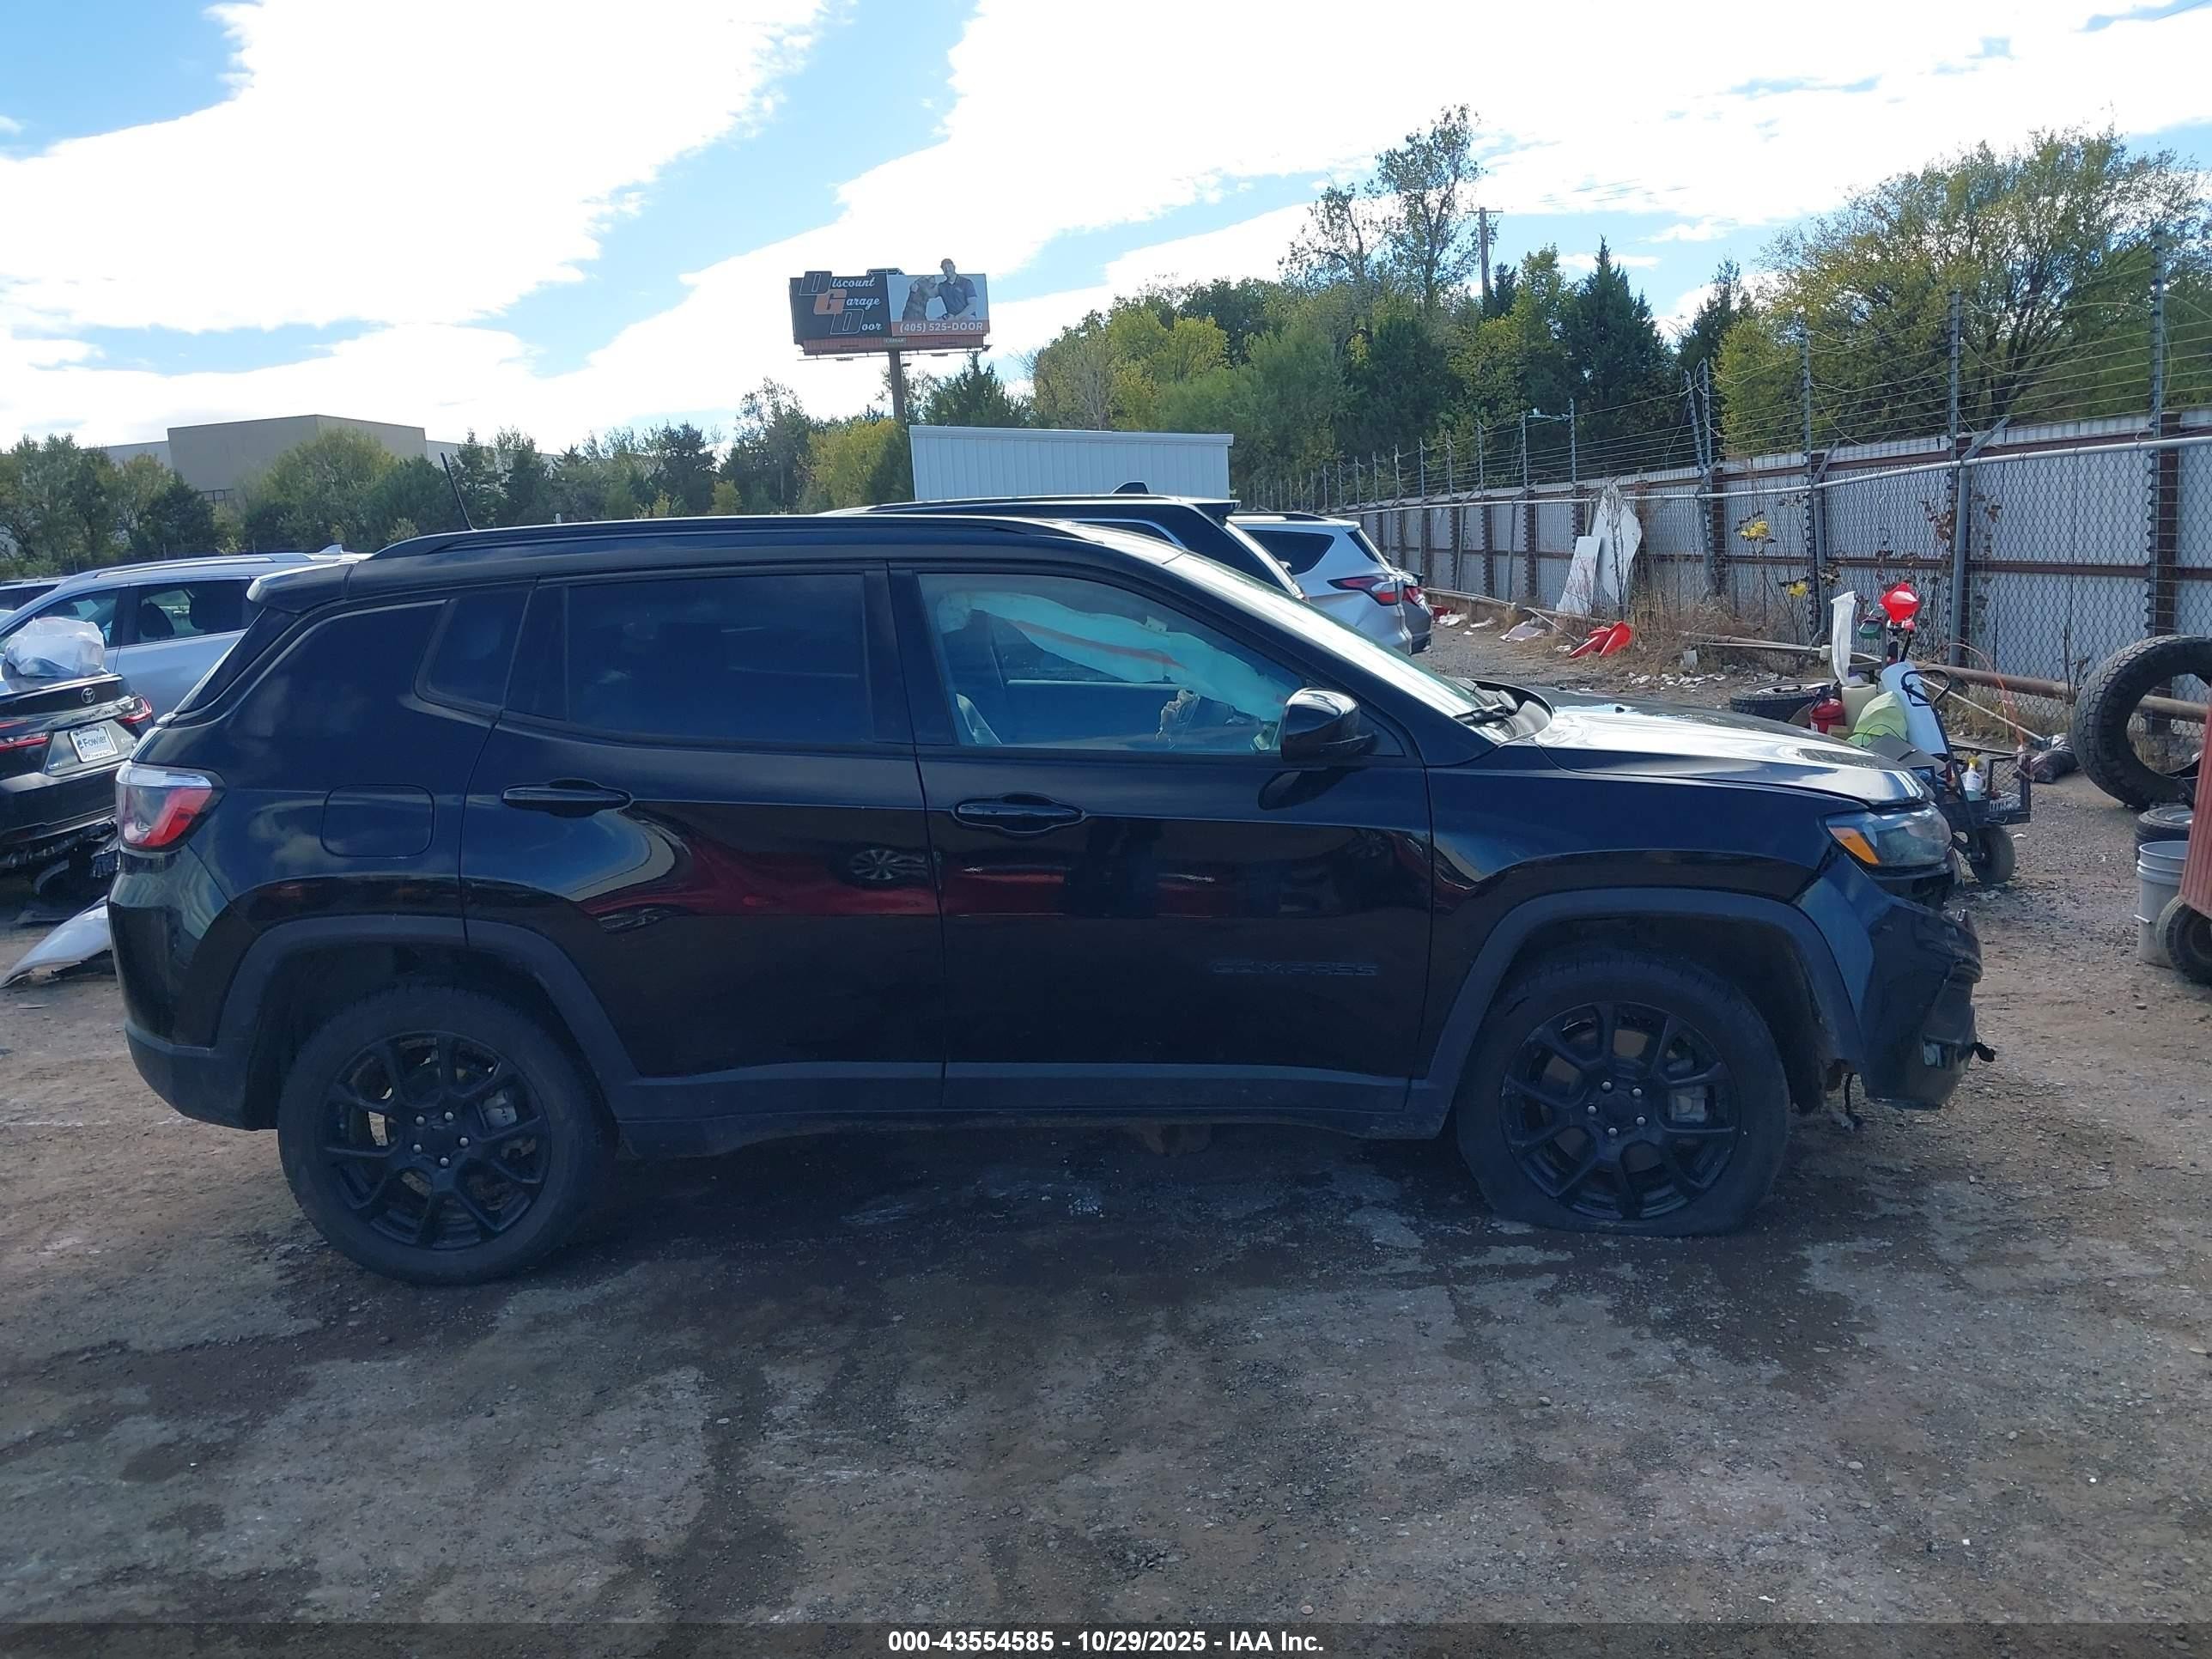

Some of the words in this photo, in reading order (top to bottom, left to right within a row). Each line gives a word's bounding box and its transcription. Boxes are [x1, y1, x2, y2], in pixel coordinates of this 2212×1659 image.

[799, 271, 876, 295] Discount
[813, 289, 881, 315] Garage
[830, 309, 883, 335] Door
[900, 322, 927, 333] (405)
[929, 322, 983, 331] 525-DOOR
